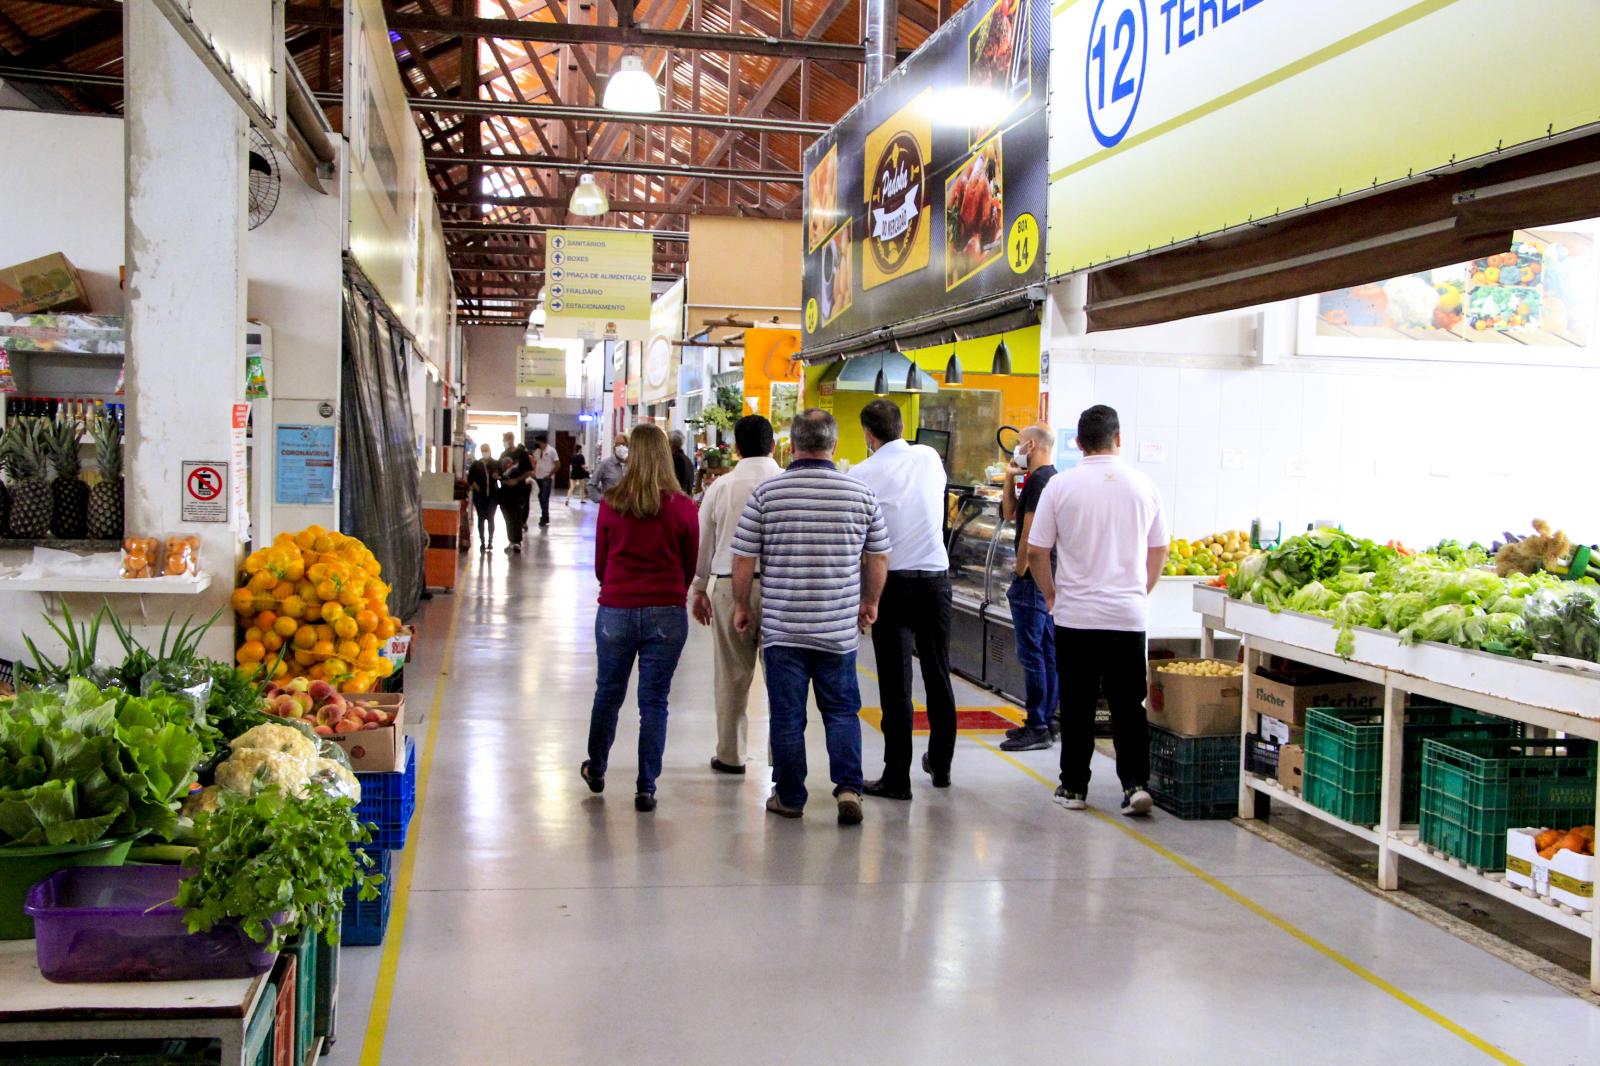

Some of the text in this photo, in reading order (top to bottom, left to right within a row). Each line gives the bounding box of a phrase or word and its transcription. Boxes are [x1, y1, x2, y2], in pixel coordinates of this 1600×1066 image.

[1092, 8, 1136, 110] 12
[882, 220, 888, 237] DO
[1017, 219, 1028, 234] BOX
[566, 255, 589, 263] BOXES
[1015, 236, 1029, 268] 14
[566, 271, 589, 280] PRAÇA
[565, 302, 625, 312] ESTACIONAMENTO
[1256, 688, 1285, 707] Fischer
